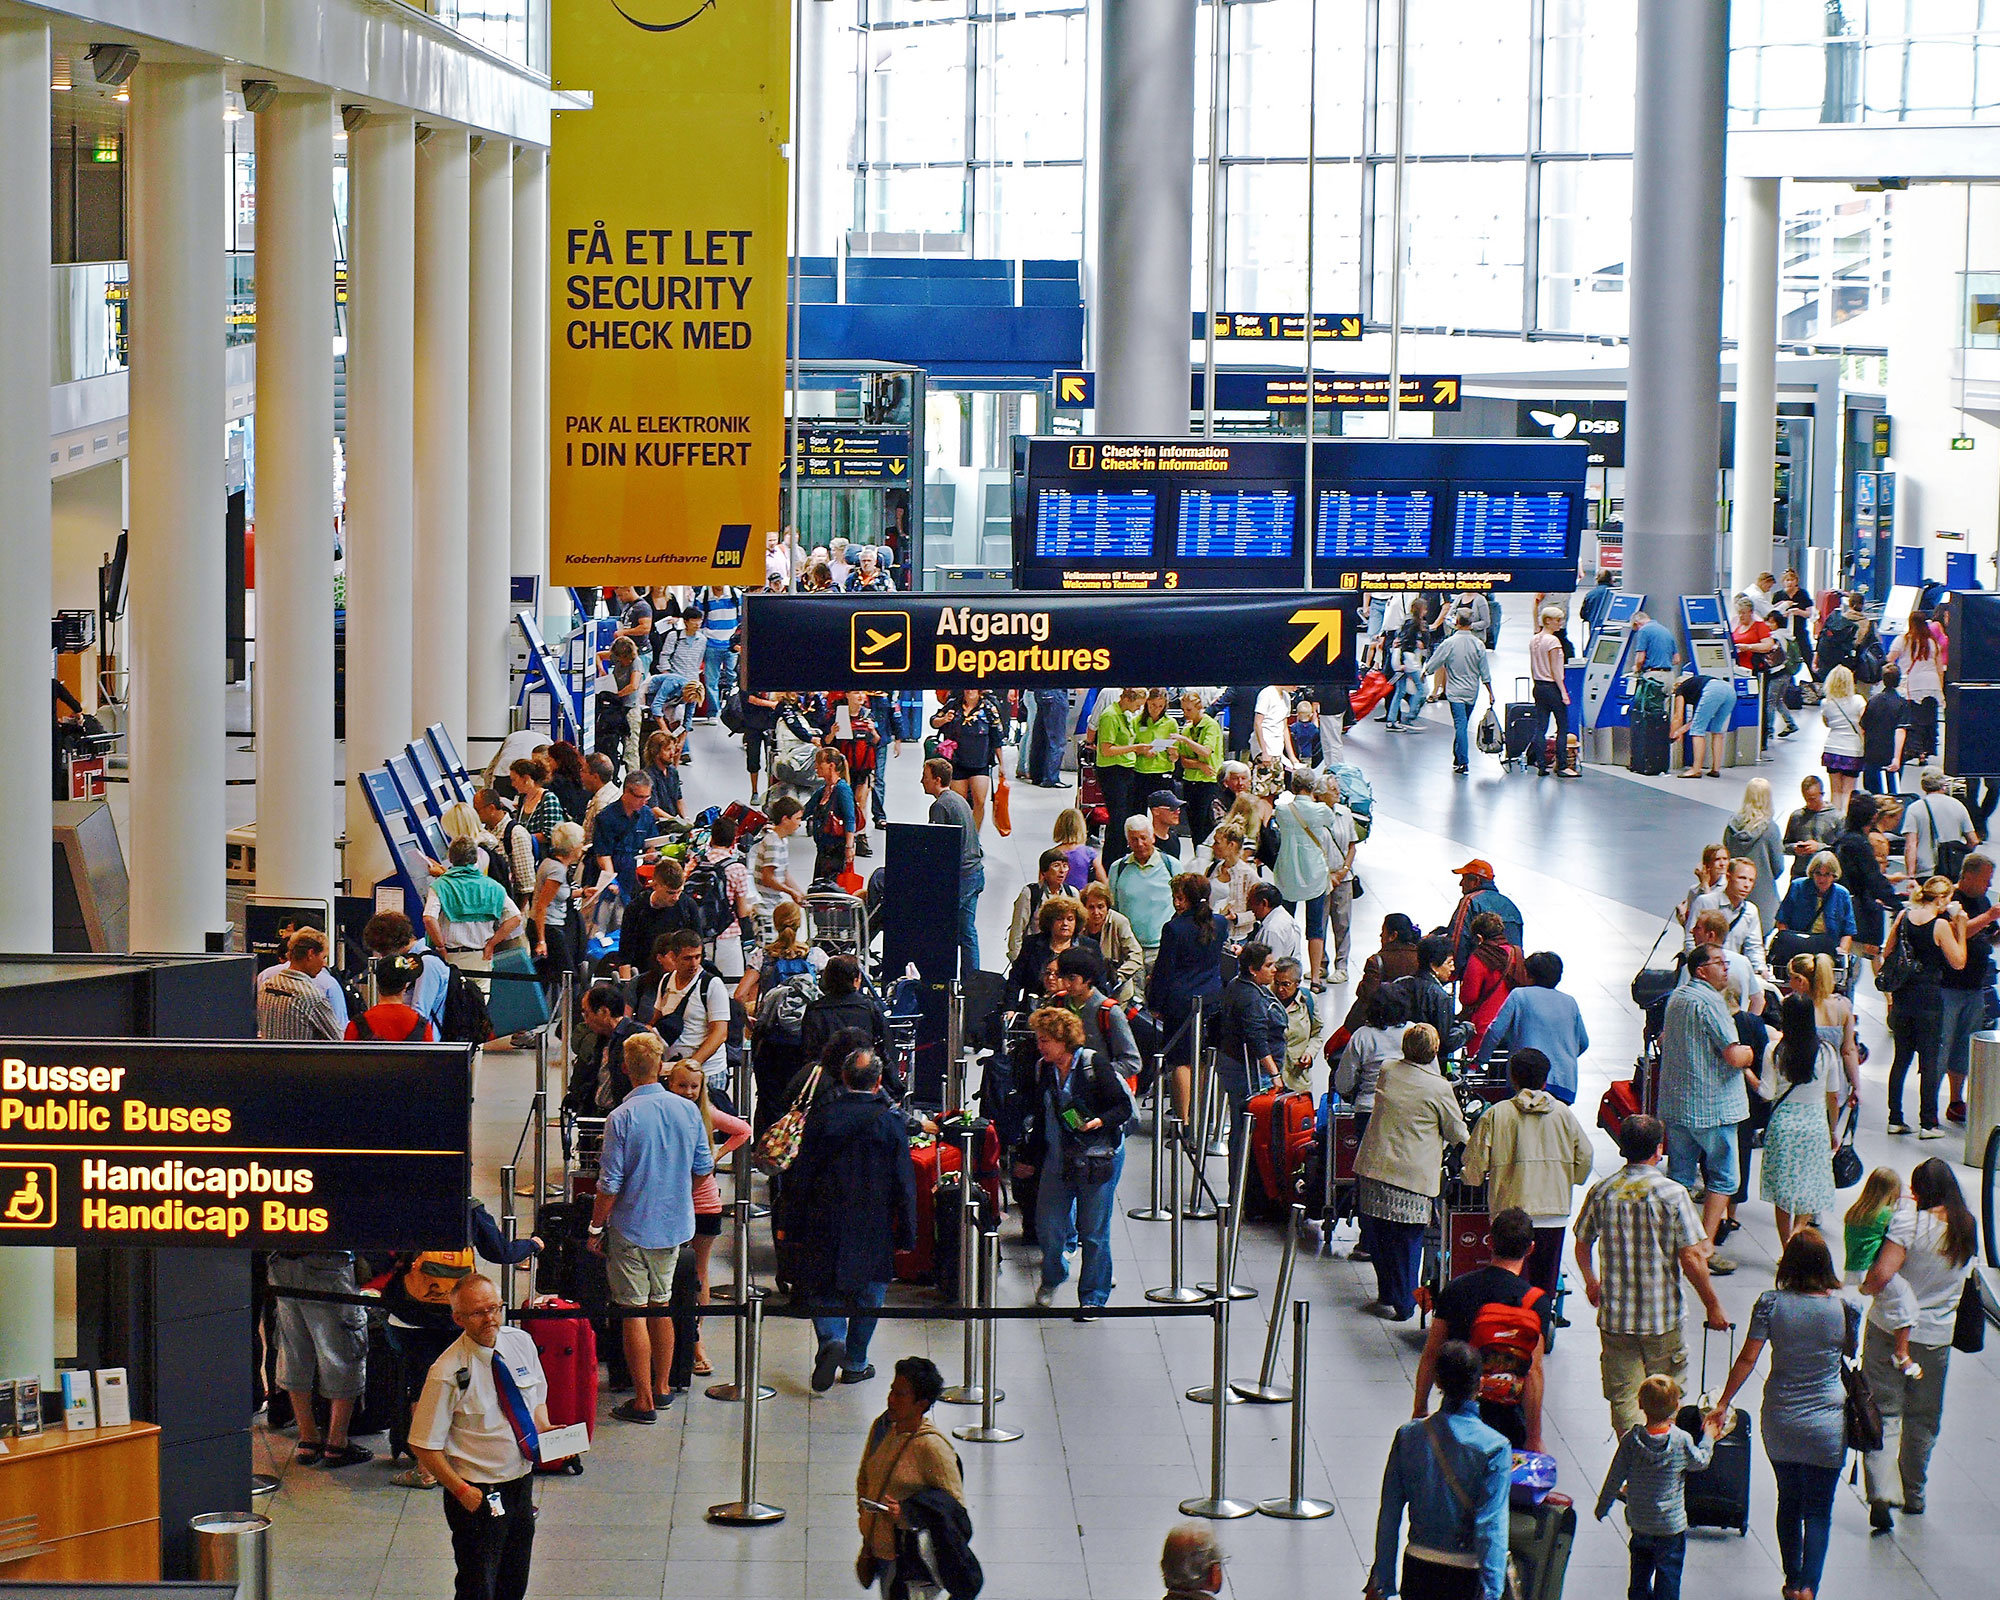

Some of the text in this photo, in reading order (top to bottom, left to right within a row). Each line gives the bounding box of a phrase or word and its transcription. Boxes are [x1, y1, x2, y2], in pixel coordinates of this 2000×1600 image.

[567, 220, 752, 266] FÅ ET LET
[567, 275, 753, 310] SECURITY
[1235, 314, 1260, 326] Spor
[1269, 316, 1279, 337] 1
[567, 320, 751, 350] CHECK MED
[1235, 326, 1264, 337] Track
[1289, 382, 1308, 391] Hote
[1289, 395, 1308, 404] Hote
[565, 415, 751, 433] PAK AL ELEKTRONIK
[1578, 420, 1620, 434] DSB
[809, 436, 828, 445] Spor
[833, 437, 845, 454] 2
[566, 442, 752, 466] I DIN KUFFERT
[810, 445, 831, 454] Track
[1101, 445, 1229, 458] Check-in information
[809, 458, 828, 468] Spor
[833, 460, 841, 476] 1
[1101, 458, 1228, 471] Check-in information
[810, 467, 831, 476] Track
[644, 553, 707, 564] Lufthavne
[715, 550, 741, 566] CPH
[1062, 571, 1111, 580] Velkommen
[1122, 571, 1158, 580] Terminal
[1164, 571, 1179, 589] 3
[1361, 572, 1386, 582] Benyt
[1419, 572, 1456, 581] Check-in
[1062, 580, 1148, 589] Welcome to Terminal
[1361, 581, 1492, 590] Please use Self Service Check-in
[935, 606, 1050, 643] Afgang
[934, 643, 1111, 679] Departures
[2, 1057, 126, 1092] Busser
[0, 1098, 233, 1133] Public Buses
[82, 1158, 314, 1200] Handicapbus
[82, 1198, 330, 1239] Handicap Bus
